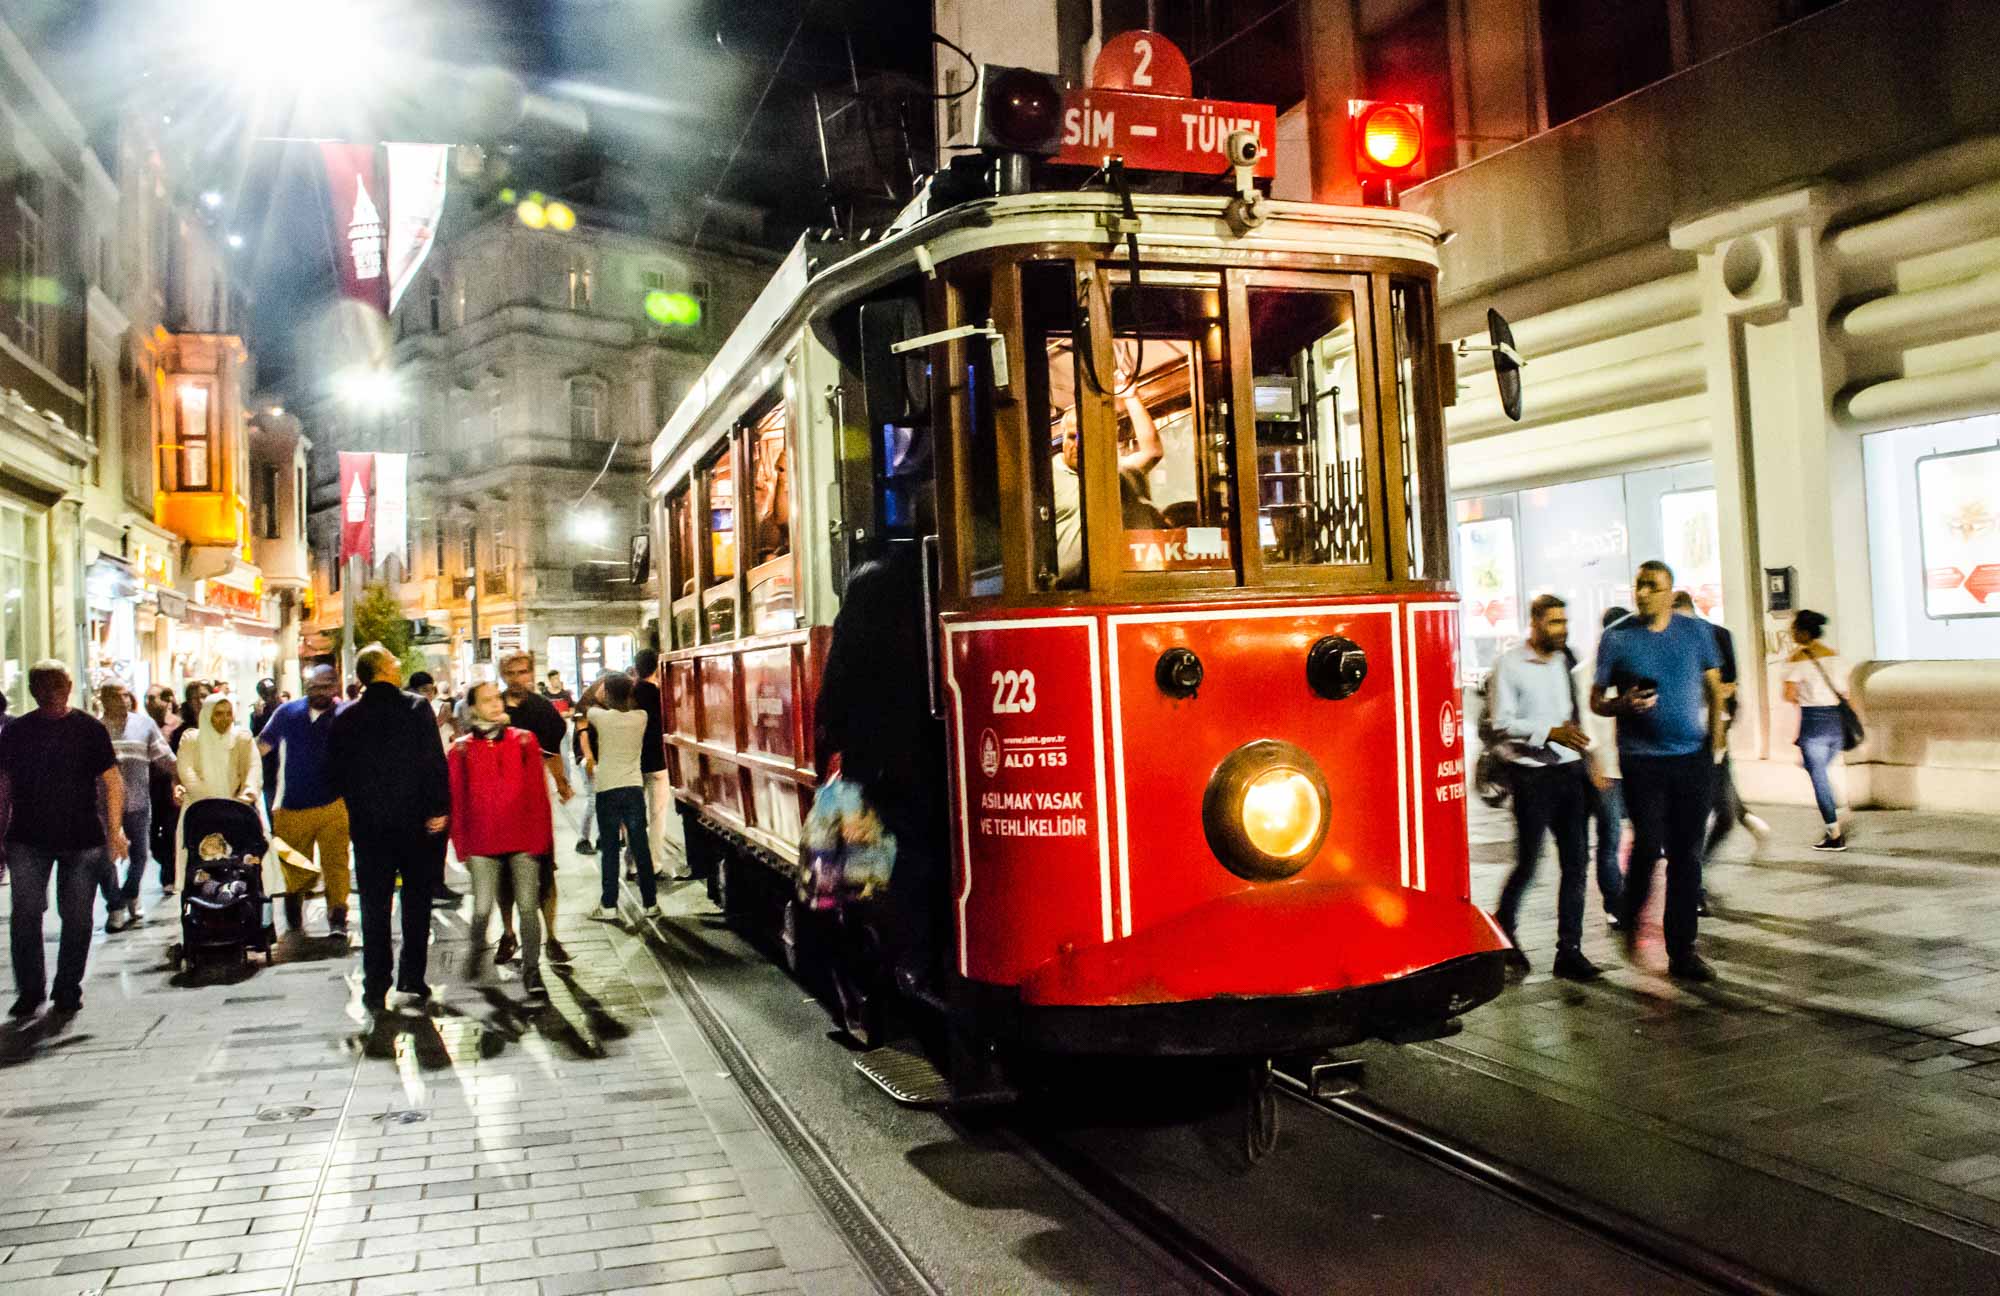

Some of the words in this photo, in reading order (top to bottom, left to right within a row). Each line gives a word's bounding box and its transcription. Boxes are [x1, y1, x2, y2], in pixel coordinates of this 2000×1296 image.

[1132, 39, 1153, 87] 2
[1061, 97, 1115, 149] SİM
[991, 668, 1036, 714] 223
[1004, 753, 1035, 768] ALO
[1038, 751, 1068, 767] 153
[981, 792, 1033, 810] ASILMAK
[1034, 791, 1083, 809] YASAK
[1435, 784, 1448, 802] VE
[980, 818, 993, 835] VE
[993, 815, 1087, 837] TEHLİKELİDİR
